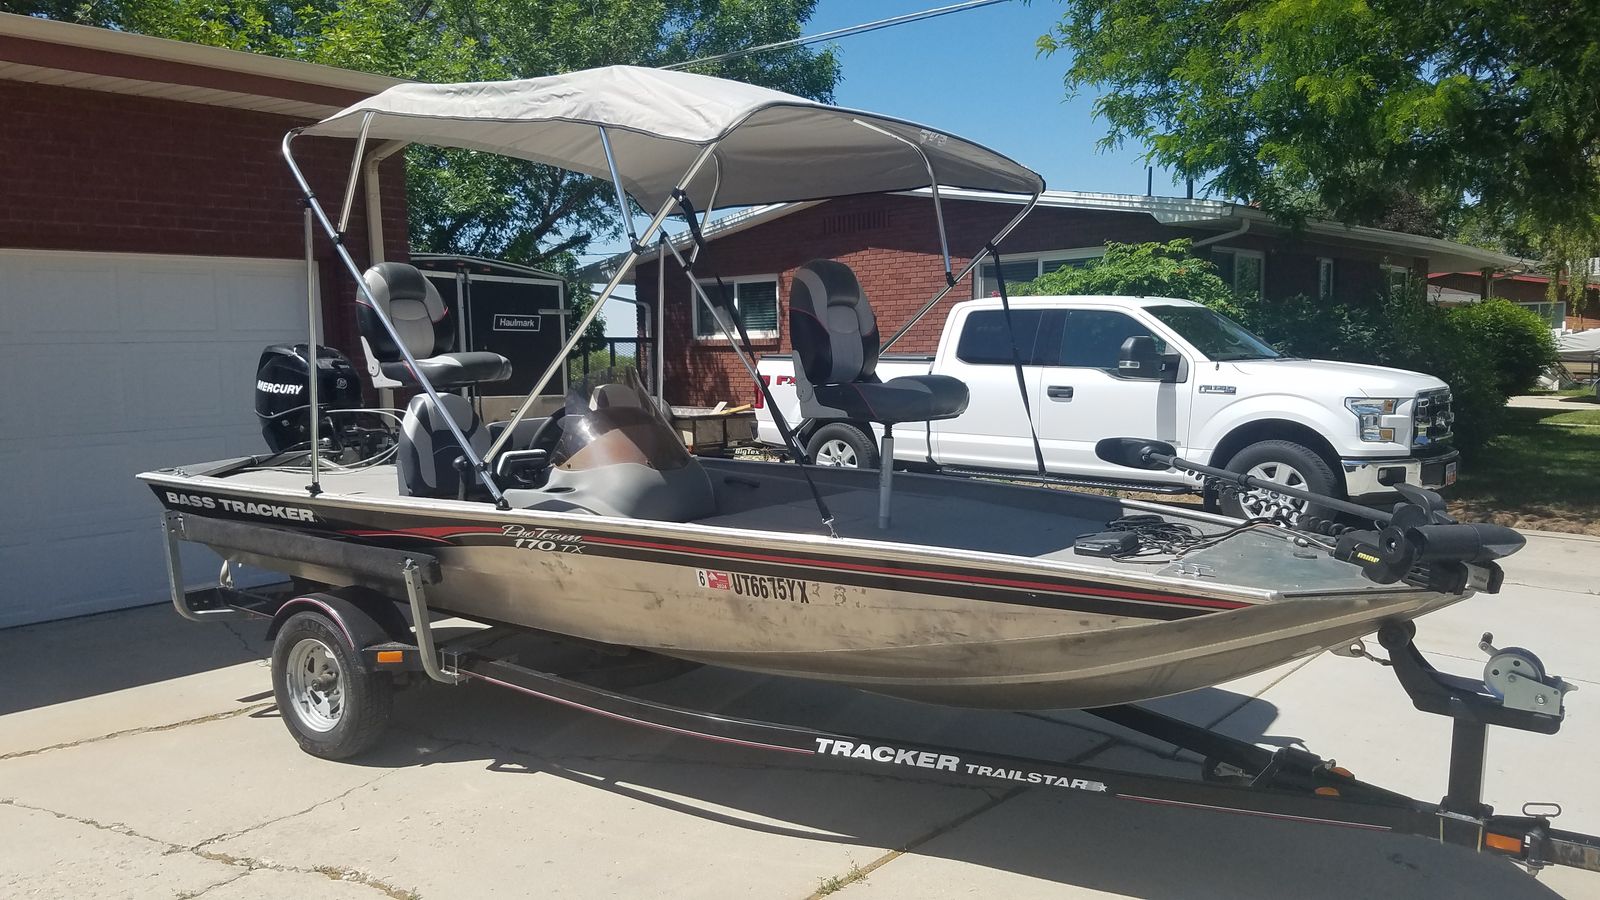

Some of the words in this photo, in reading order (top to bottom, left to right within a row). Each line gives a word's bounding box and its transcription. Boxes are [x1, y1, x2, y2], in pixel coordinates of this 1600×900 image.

[500, 318, 535, 327] Haulmark
[257, 380, 303, 394] MERCURY
[166, 492, 216, 509] BASS
[219, 499, 316, 522] TRACKER
[514, 539, 557, 551] 170
[561, 544, 586, 554] TX
[698, 571, 706, 586] 6
[732, 573, 810, 604] UT6675YX
[815, 738, 960, 772] TRACKER
[965, 764, 1090, 790] TRAILSTAR
